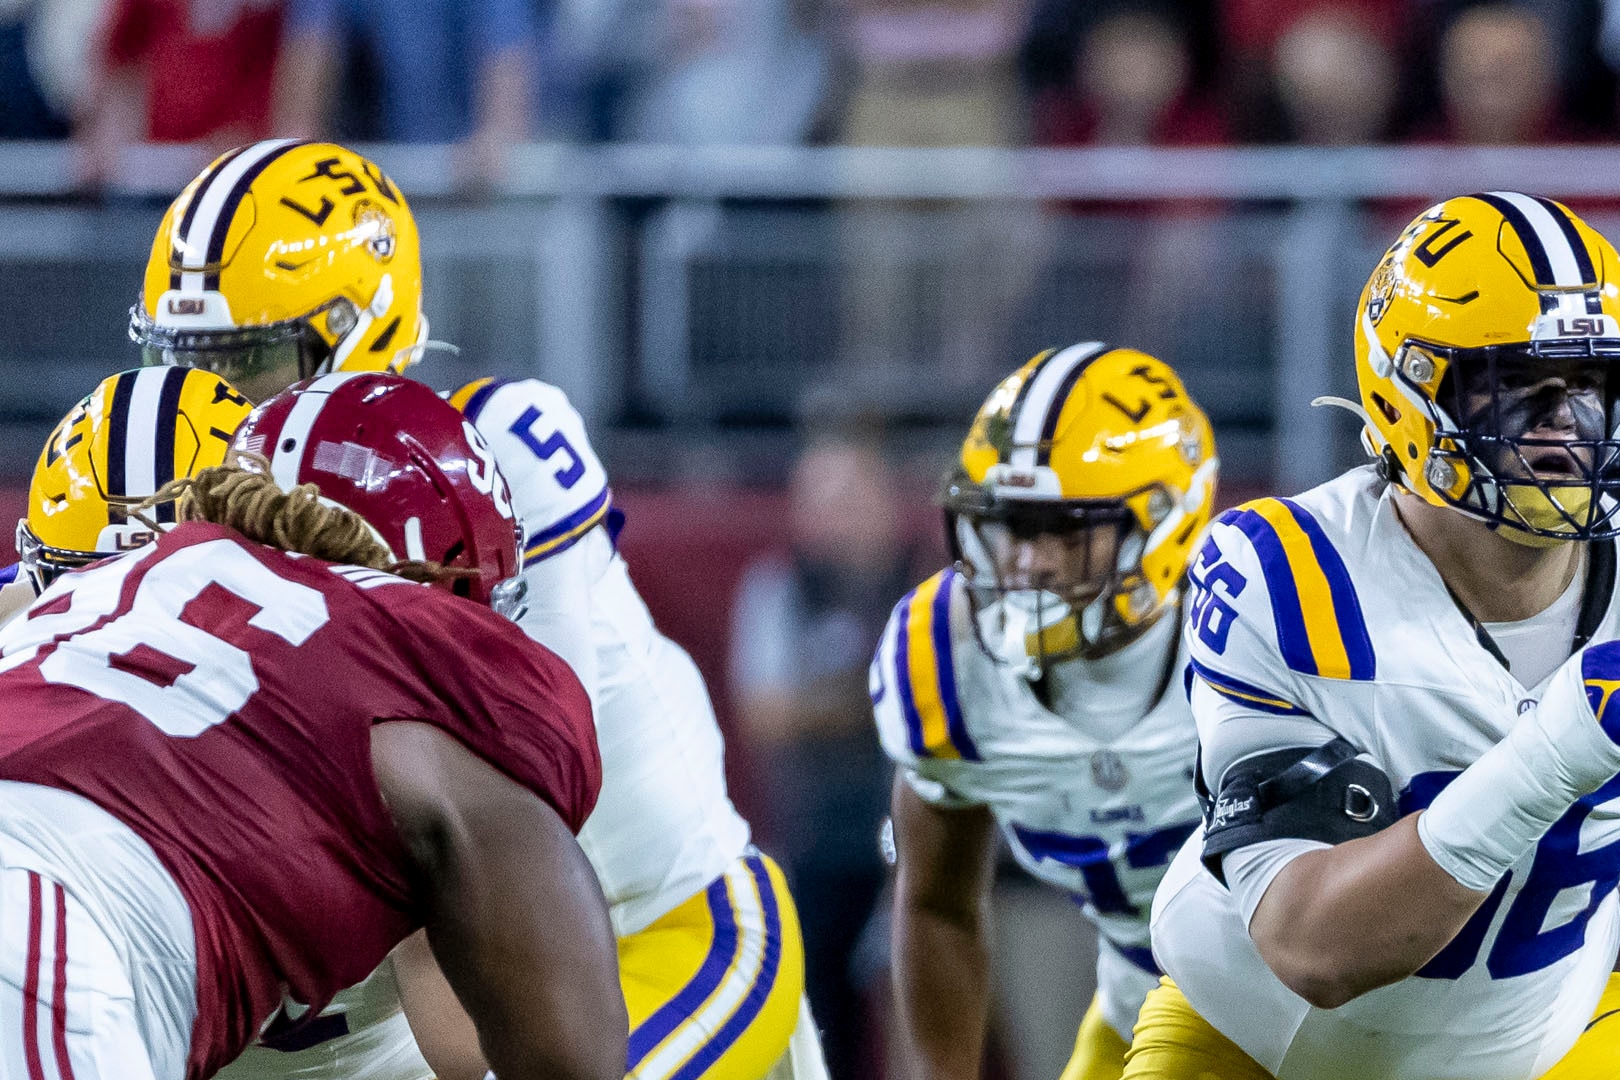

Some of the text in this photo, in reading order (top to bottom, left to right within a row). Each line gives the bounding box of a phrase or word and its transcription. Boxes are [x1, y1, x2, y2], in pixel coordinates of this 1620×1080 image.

[1557, 318, 1605, 337] LSU
[508, 404, 586, 490] 5
[115, 532, 155, 551] LS
